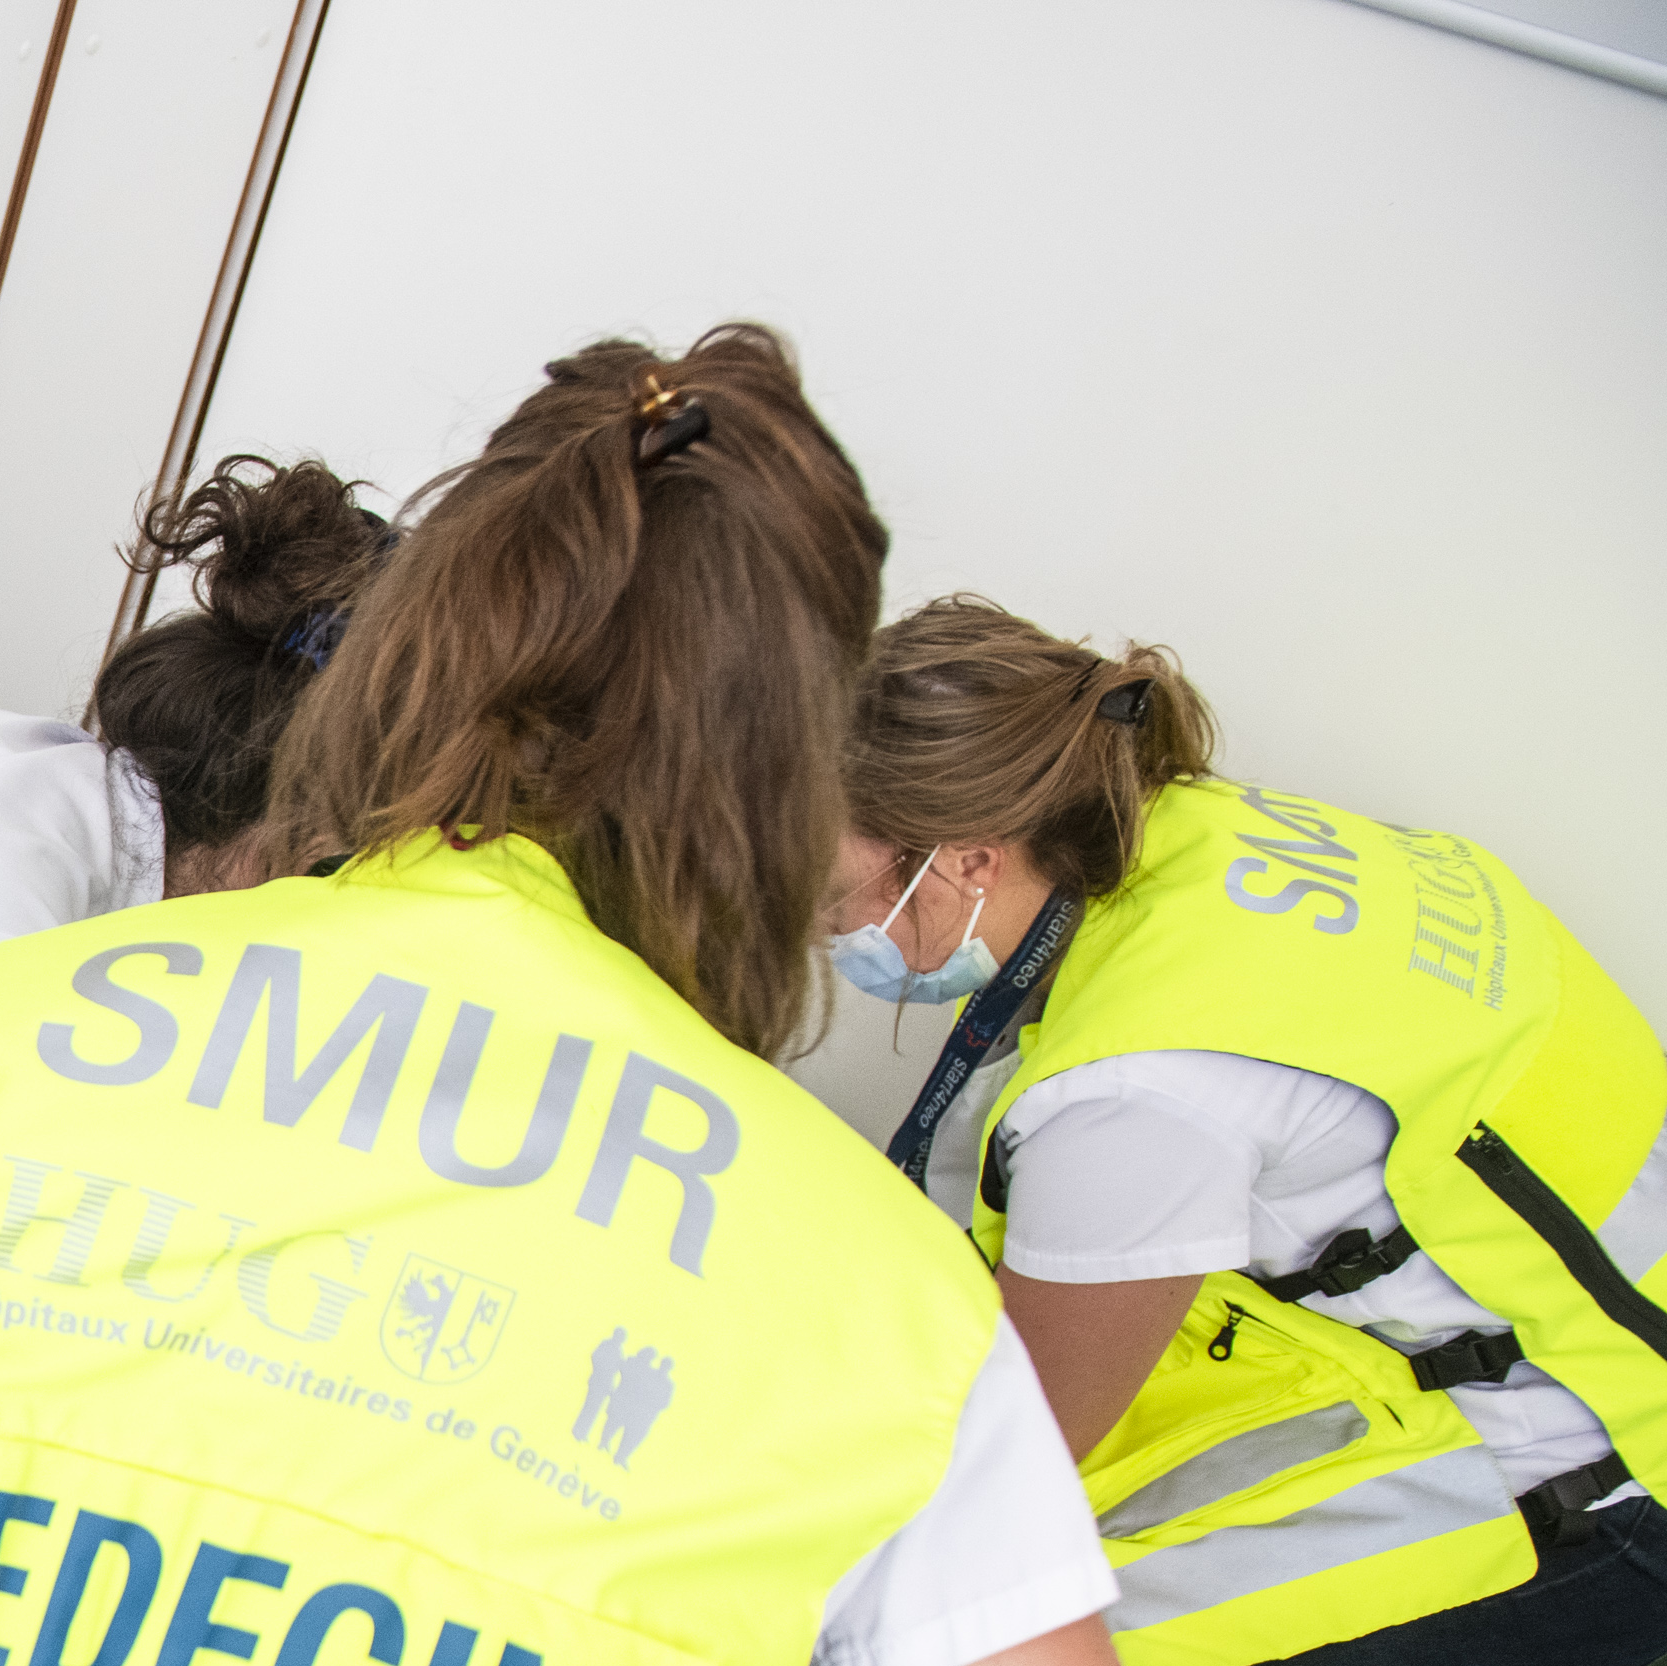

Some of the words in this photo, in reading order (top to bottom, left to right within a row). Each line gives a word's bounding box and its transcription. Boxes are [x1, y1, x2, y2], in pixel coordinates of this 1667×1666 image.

[1012, 900, 1077, 989] start4neo
[1484, 943, 1506, 1010] Hôpitaux
[35, 940, 742, 1281] SMUR
[917, 1057, 968, 1127] start4neo
[142, 1320, 415, 1426] Universitaires
[426, 1404, 477, 1443] de
[489, 1421, 622, 1524] Genève
